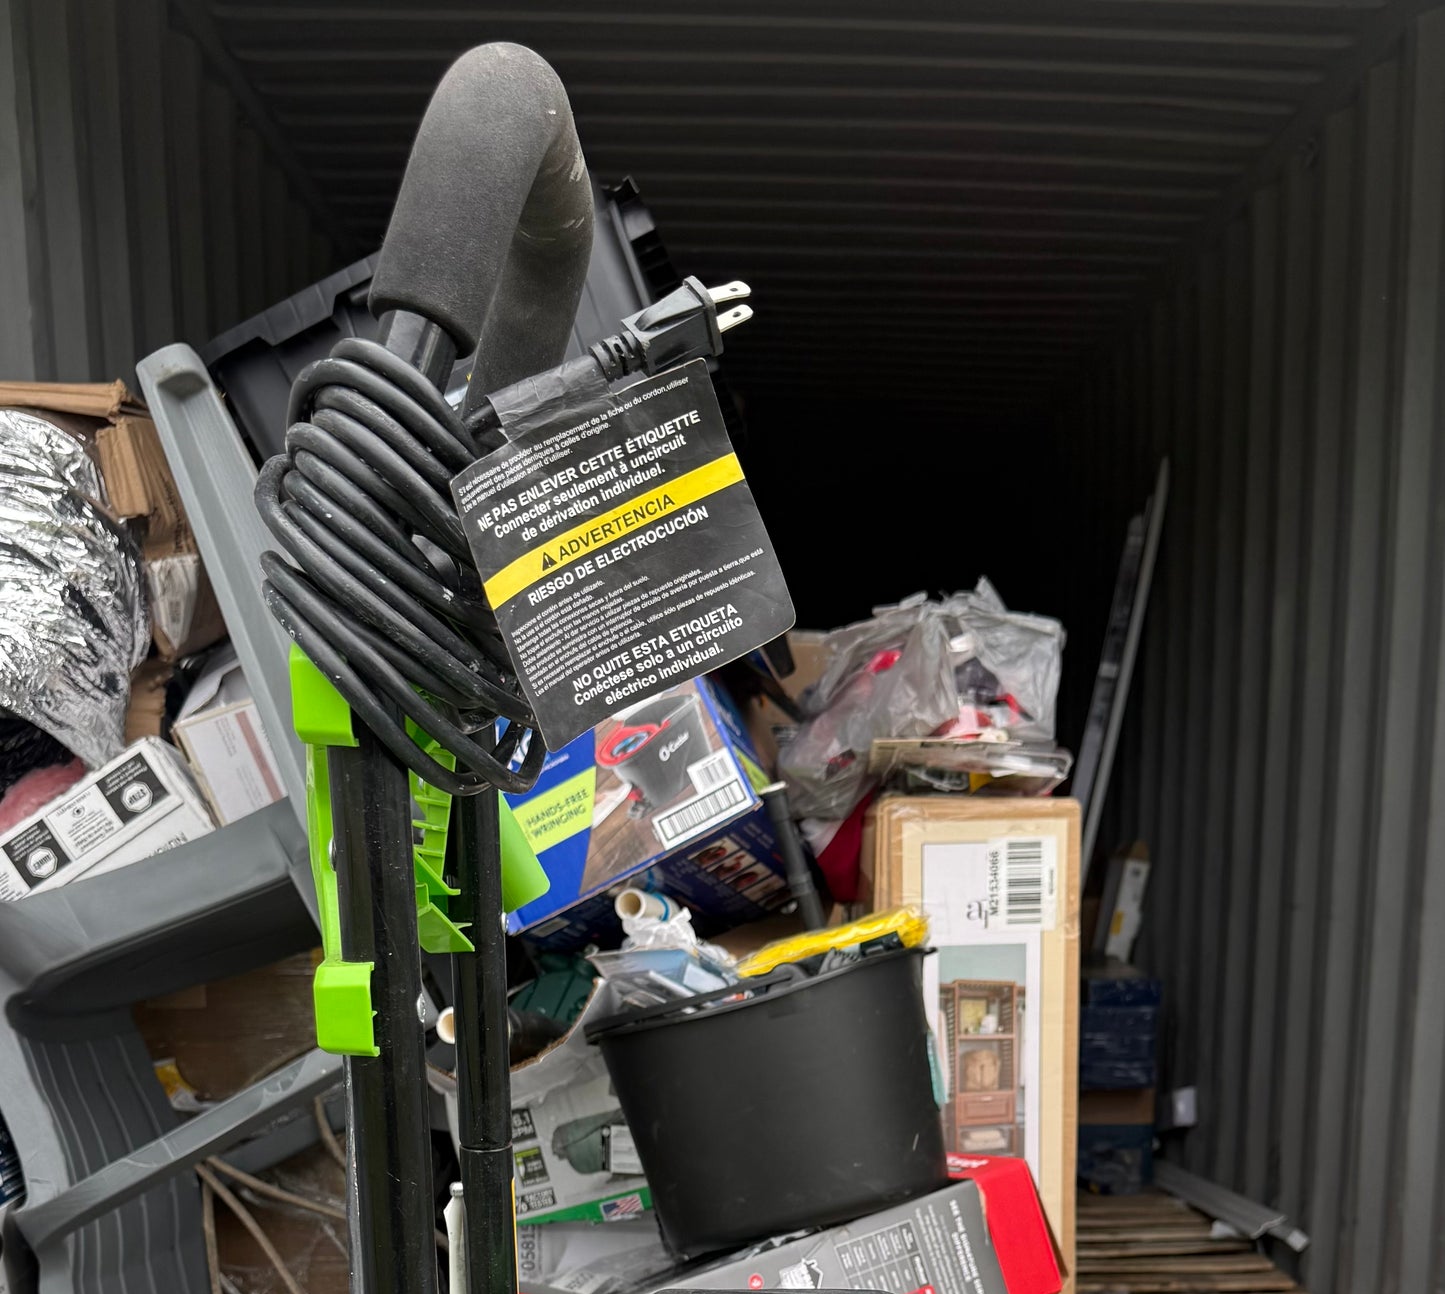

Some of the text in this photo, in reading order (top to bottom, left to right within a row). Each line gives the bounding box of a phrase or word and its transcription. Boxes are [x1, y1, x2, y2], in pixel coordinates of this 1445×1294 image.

[478, 410, 700, 531] NE PAS ENLEVER CETTE ÉTIQUETTE
[501, 460, 509, 469] de
[508, 447, 532, 467] procéder
[544, 421, 590, 447] remplacement
[591, 416, 600, 425] de
[600, 413, 607, 421] la
[608, 406, 624, 417] fiche
[633, 397, 642, 405] du
[495, 434, 686, 538] Connecter seulement à uncircuit
[522, 464, 665, 541] de dérivation individuel.
[528, 506, 709, 606] RIESGO DE ELECTROCUCIÓN
[559, 495, 675, 560] ADVERTENCIA
[573, 603, 737, 692] NO QUITE ESTA ETIQUETA
[574, 617, 743, 705] Conéctese solo a un circuito
[605, 642, 724, 705] eléctrico individual.
[527, 789, 590, 827] HANDS-FREE
